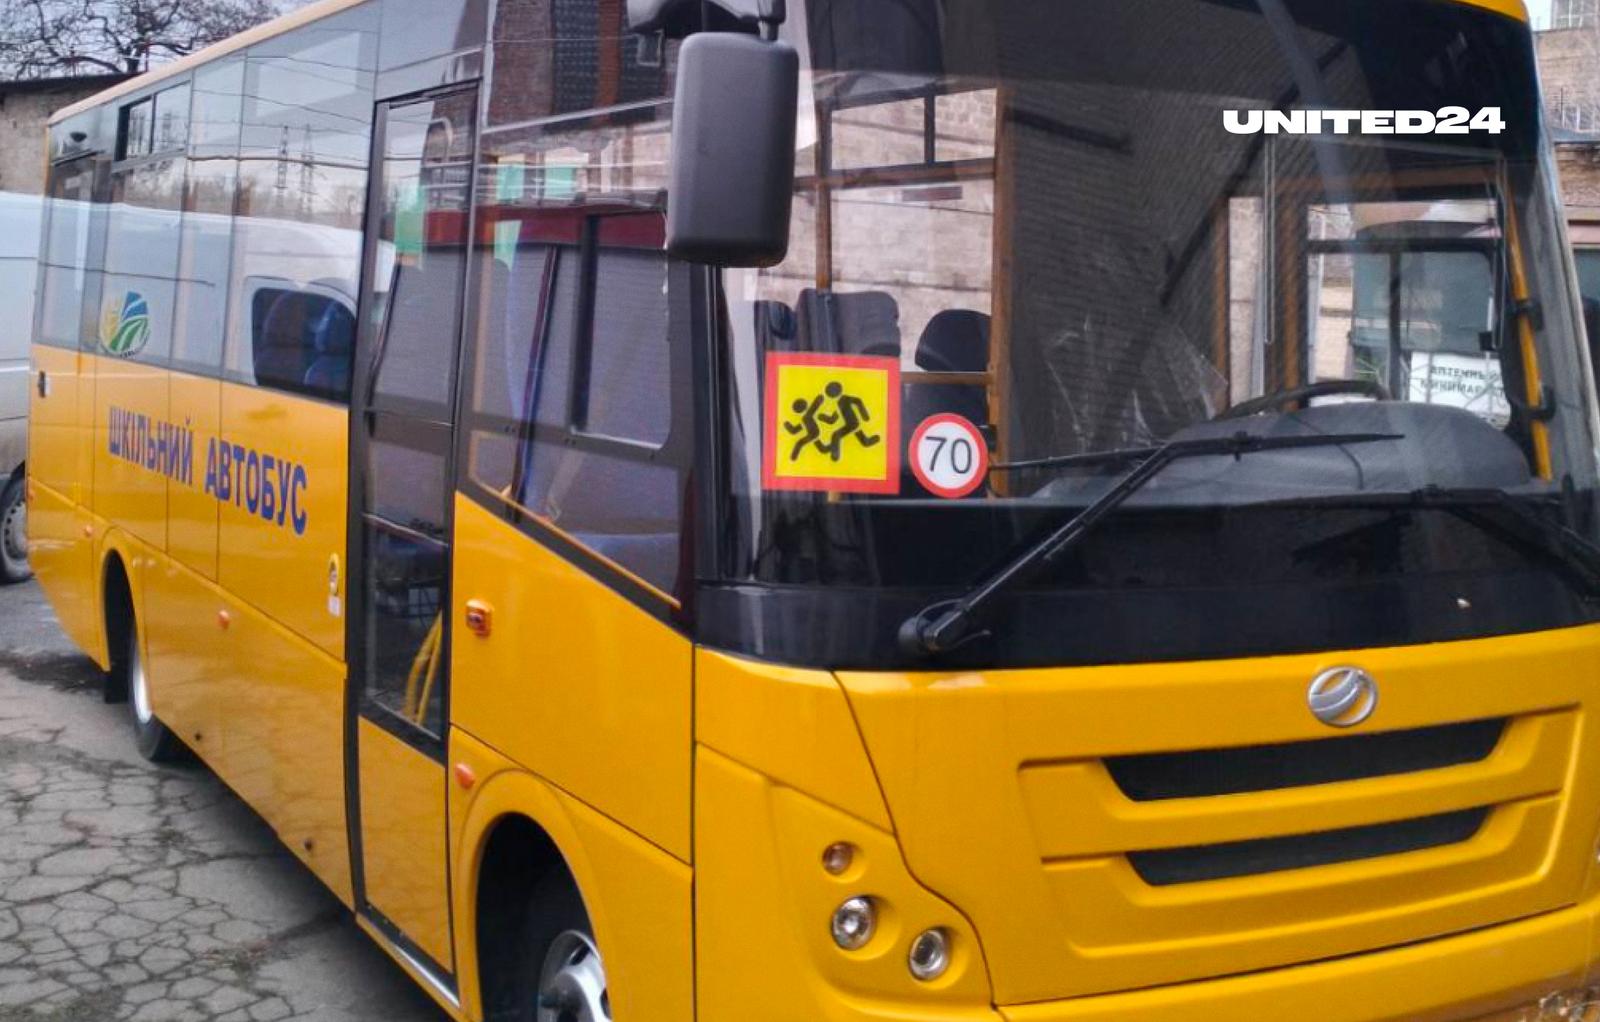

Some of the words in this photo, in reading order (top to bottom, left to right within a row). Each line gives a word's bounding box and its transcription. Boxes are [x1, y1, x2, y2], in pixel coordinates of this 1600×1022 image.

[109, 407, 193, 487] ШКІЛЬНИЙ
[205, 436, 307, 536] АВТОБУС
[925, 435, 972, 474] 70
